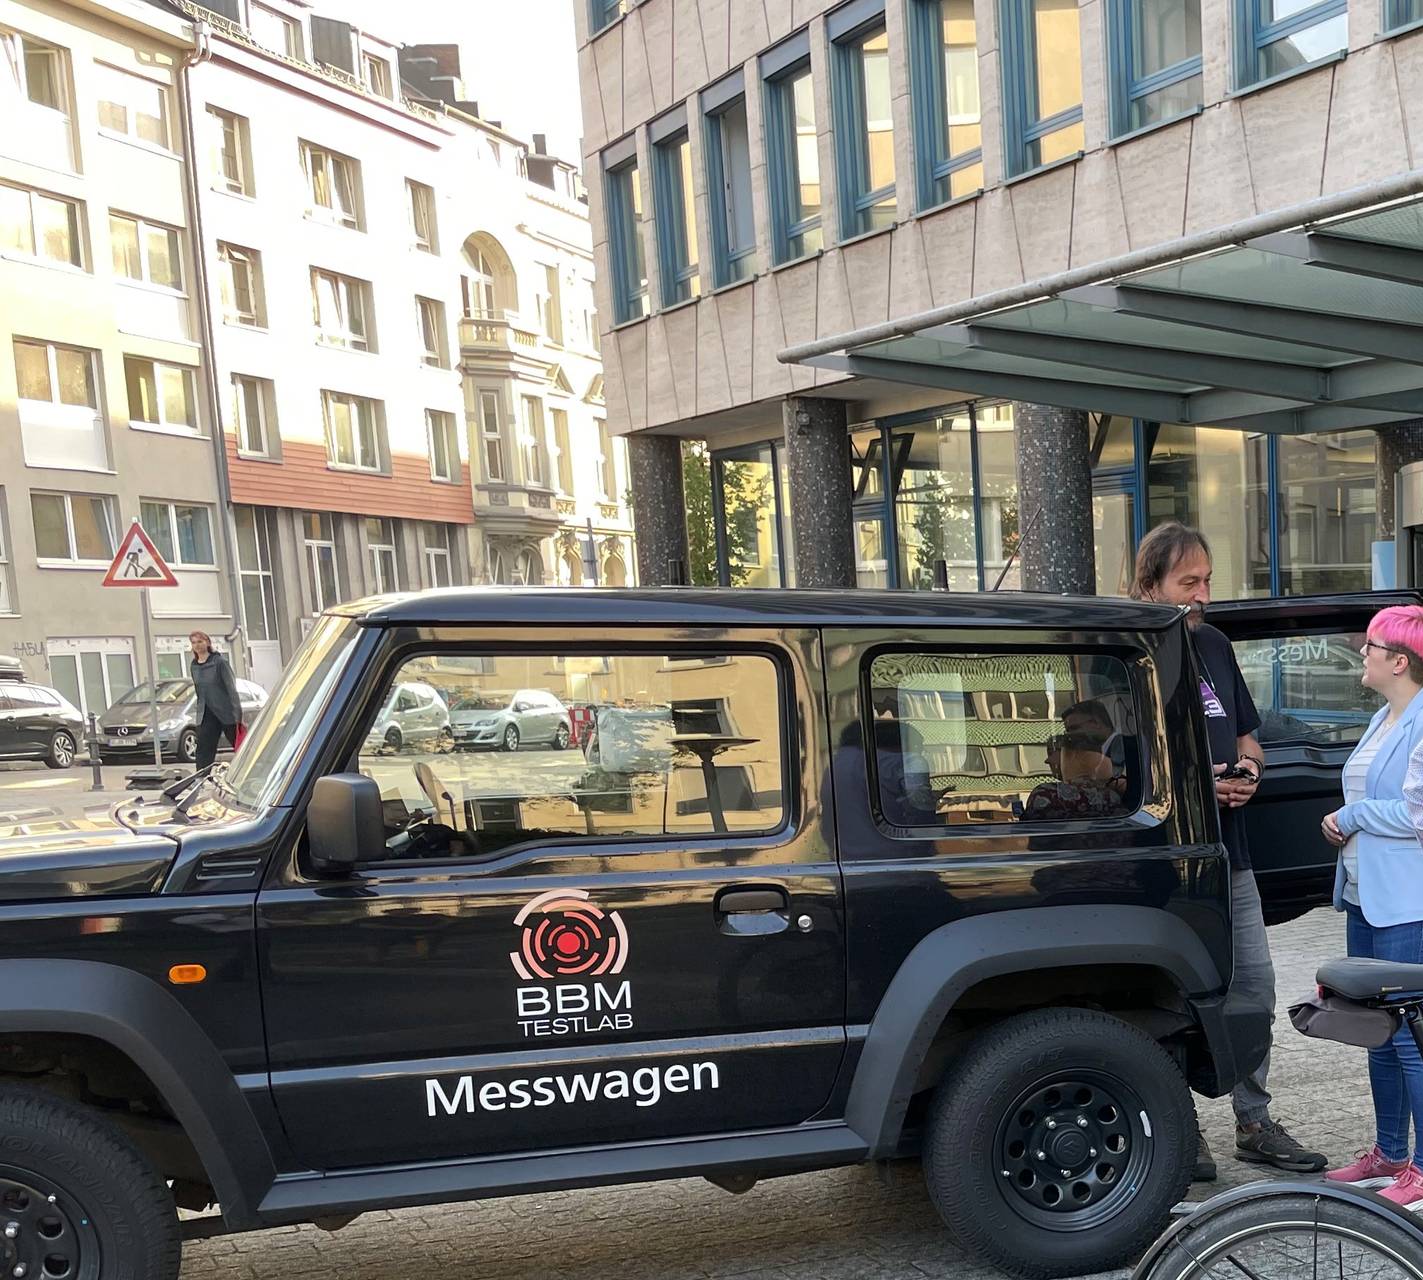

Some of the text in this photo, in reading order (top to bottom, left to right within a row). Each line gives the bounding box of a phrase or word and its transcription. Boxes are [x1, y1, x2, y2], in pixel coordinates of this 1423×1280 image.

[516, 981, 632, 1017] BBM
[517, 1013, 634, 1037] TESTLAB
[424, 1060, 720, 1117] Messwagen
